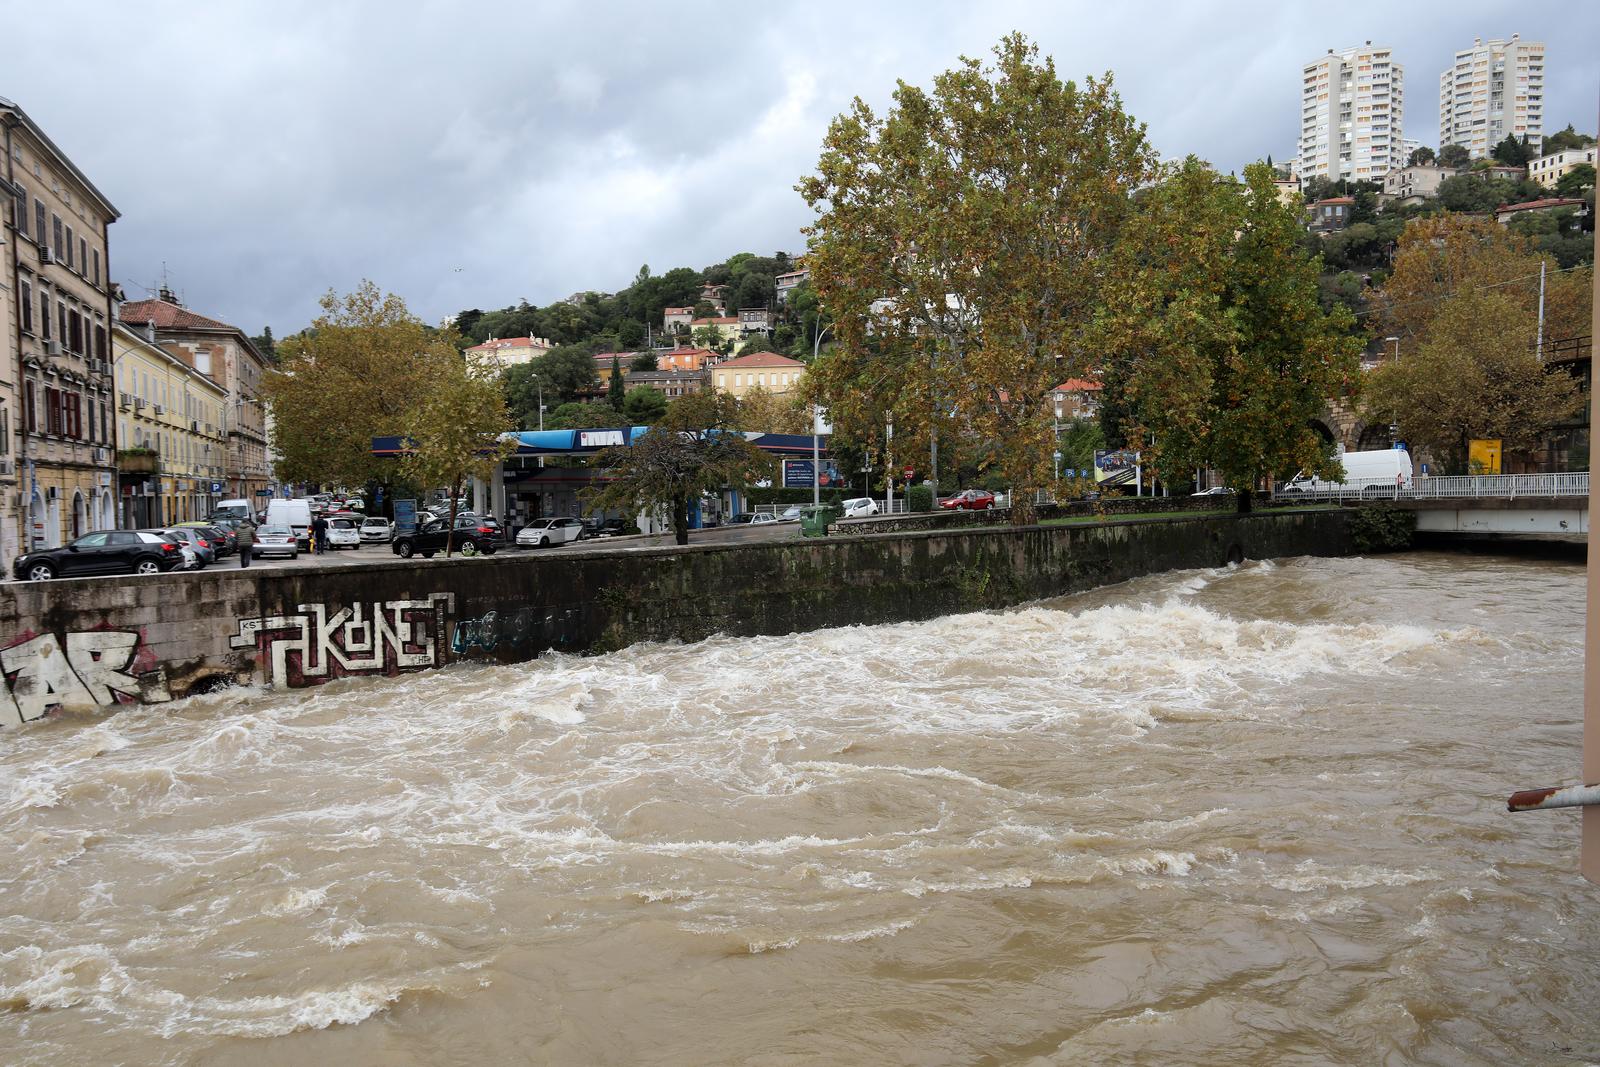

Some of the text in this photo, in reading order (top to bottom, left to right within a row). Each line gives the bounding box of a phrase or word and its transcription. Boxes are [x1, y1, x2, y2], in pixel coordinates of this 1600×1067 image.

[581, 431, 625, 447] INA
[213, 483, 219, 491] P
[378, 486, 384, 495] P
